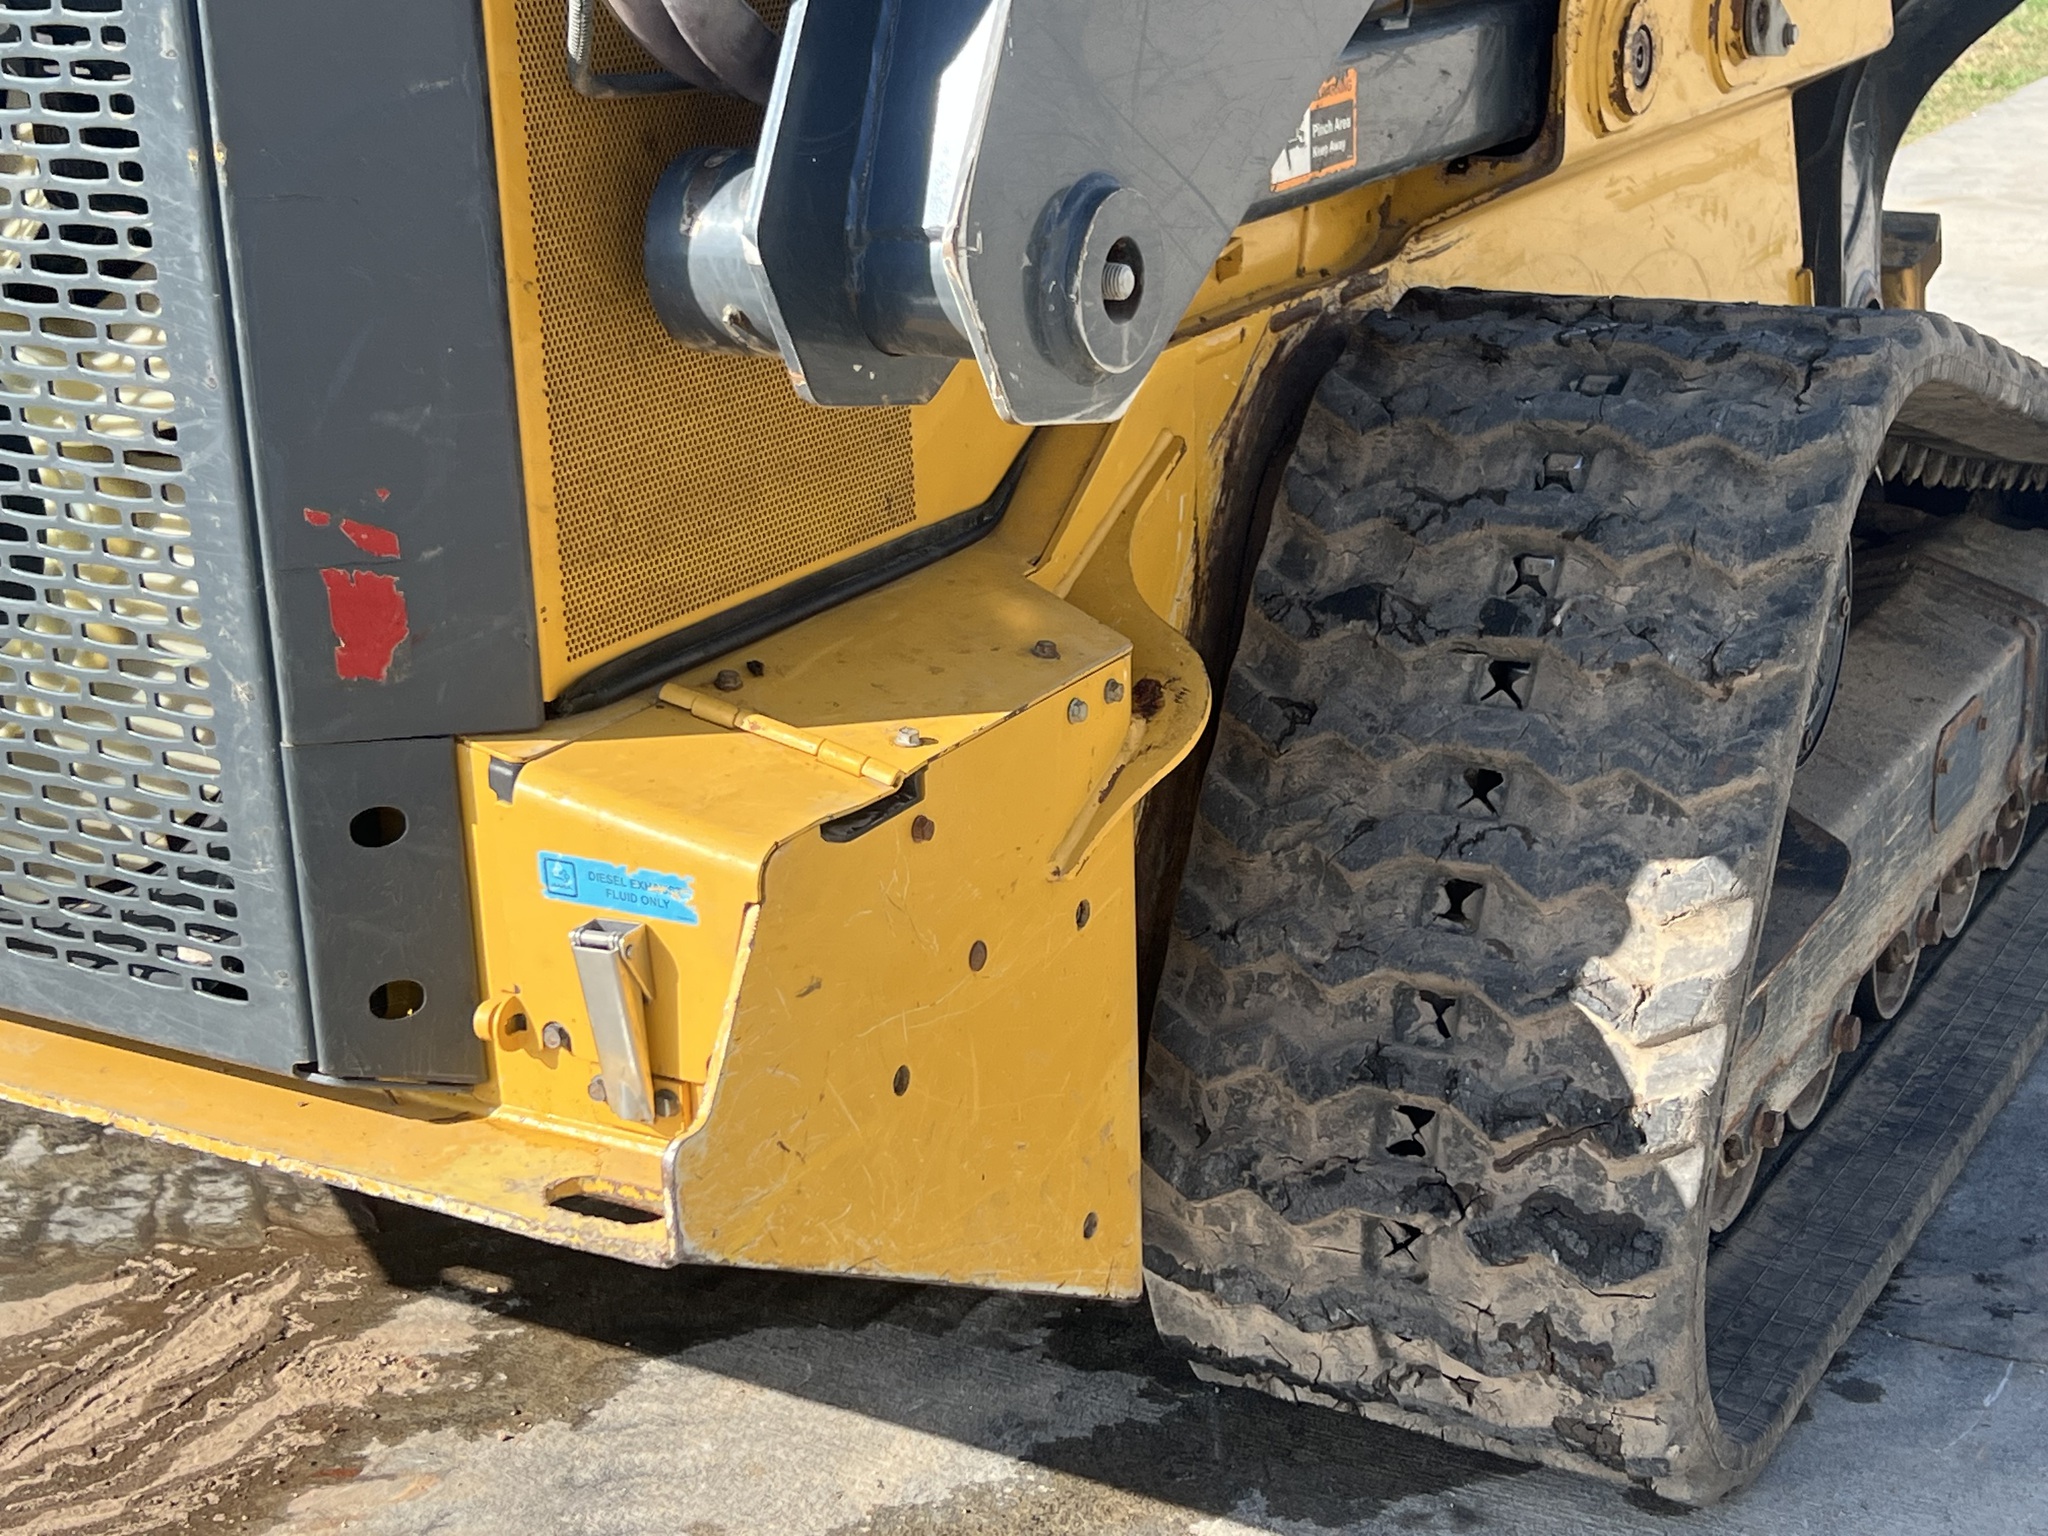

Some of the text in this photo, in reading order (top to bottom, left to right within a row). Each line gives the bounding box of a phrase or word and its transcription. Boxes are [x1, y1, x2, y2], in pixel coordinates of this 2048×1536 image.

[1312, 117, 1351, 138] Pinch Area
[1329, 140, 1346, 152] Away
[588, 871, 627, 887] DIESEL
[629, 878, 682, 896] EXHST
[605, 888, 671, 909] FLUID ONLY
